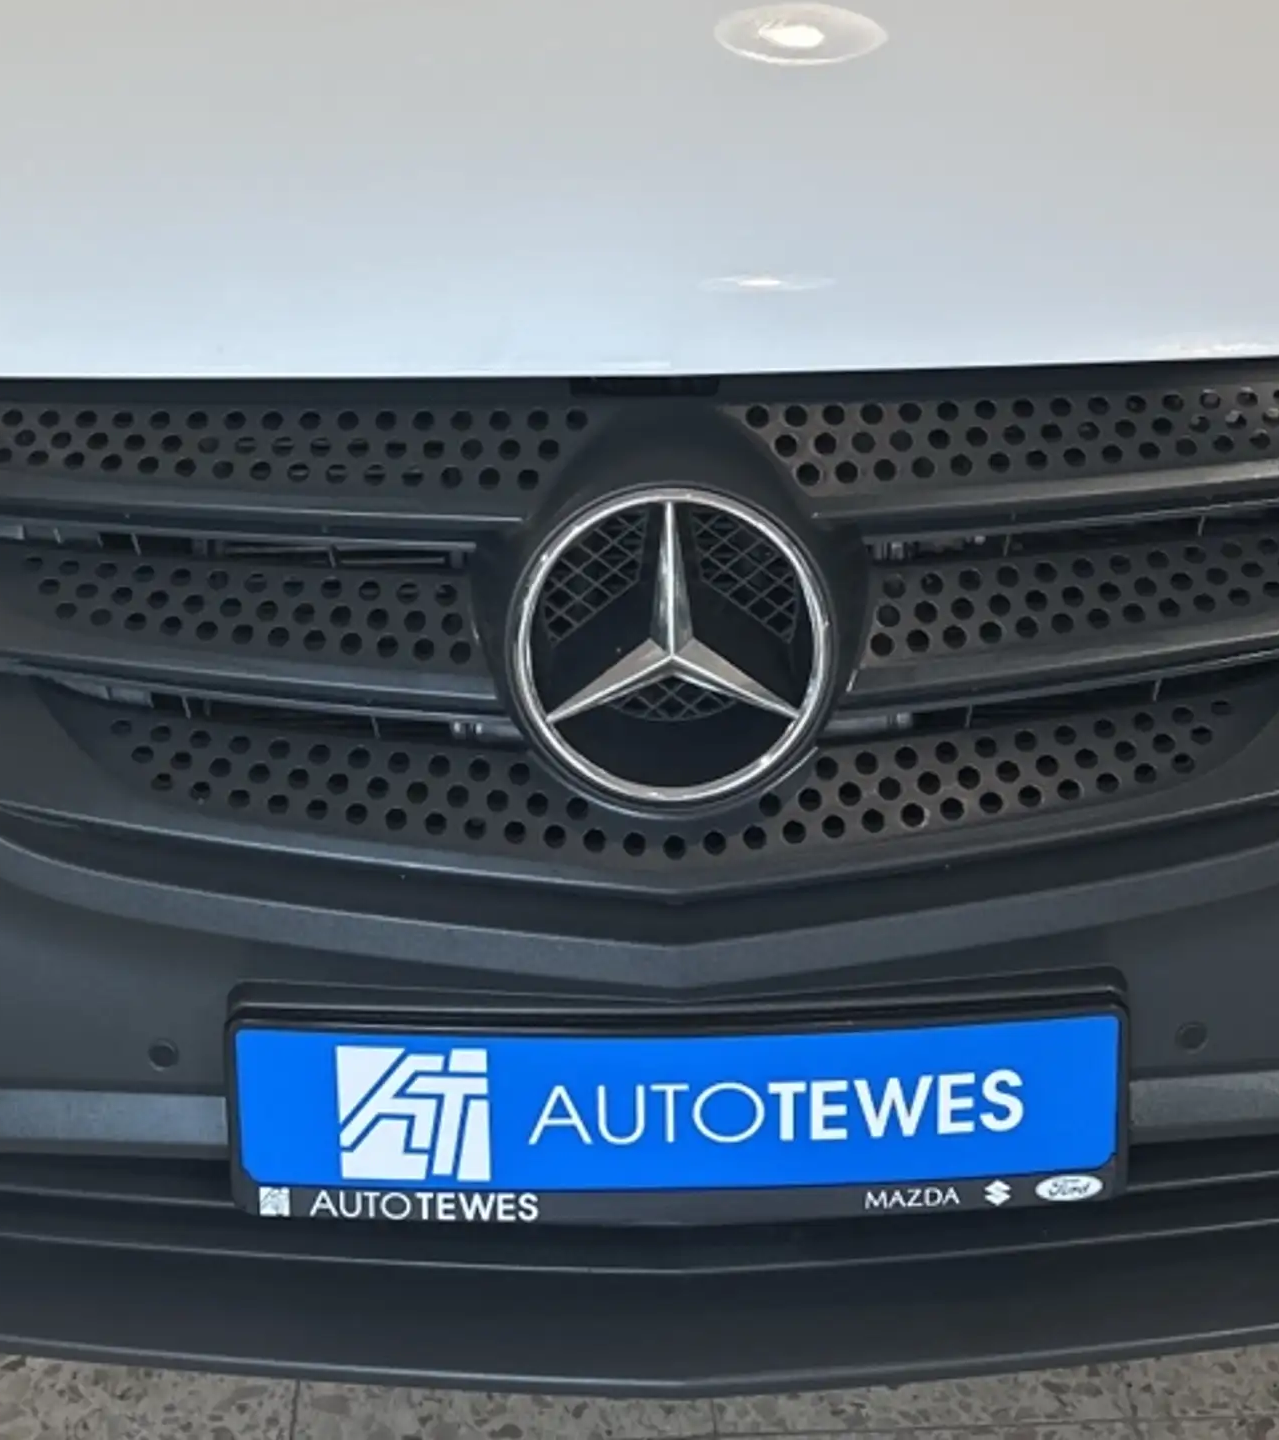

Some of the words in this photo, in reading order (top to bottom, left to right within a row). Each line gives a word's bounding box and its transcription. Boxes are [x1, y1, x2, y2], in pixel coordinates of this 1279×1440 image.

[528, 1069, 1025, 1145] AUTOTEWES
[863, 1187, 961, 1210] MAZDA
[1046, 1177, 1094, 1198] Ford
